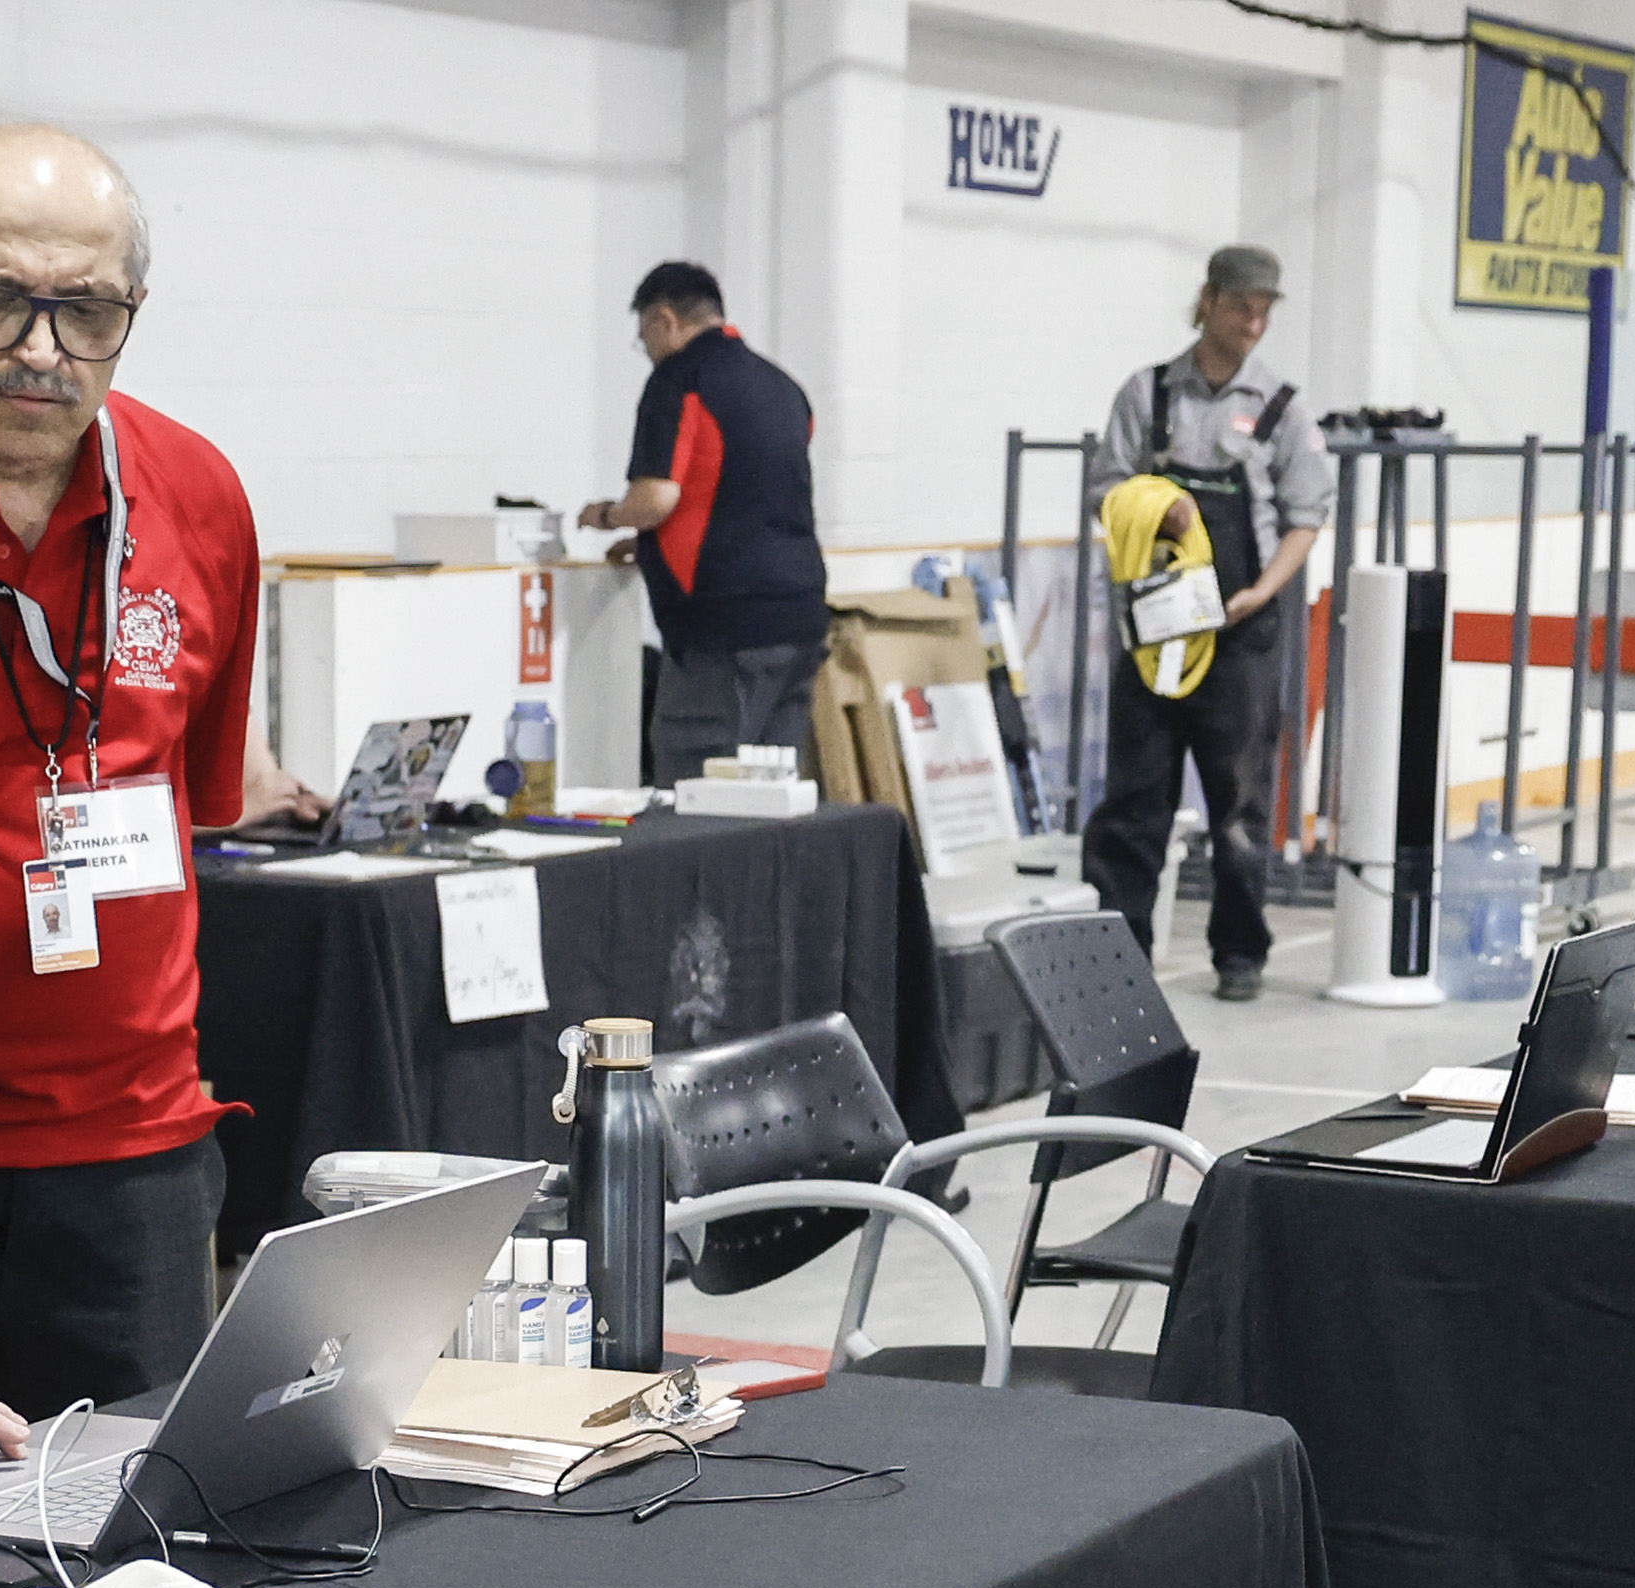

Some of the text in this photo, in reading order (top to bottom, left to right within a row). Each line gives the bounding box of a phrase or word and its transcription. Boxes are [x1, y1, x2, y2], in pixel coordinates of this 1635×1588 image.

[1512, 55, 1604, 160] Auto
[948, 107, 1042, 194] HOME
[1502, 148, 1605, 252] Value
[1545, 262, 1590, 298] STOR
[131, 660, 161, 673] CEMA
[60, 832, 150, 852] ATHNAKARA
[87, 854, 128, 868] ERTA
[30, 881, 55, 891] Calgary
